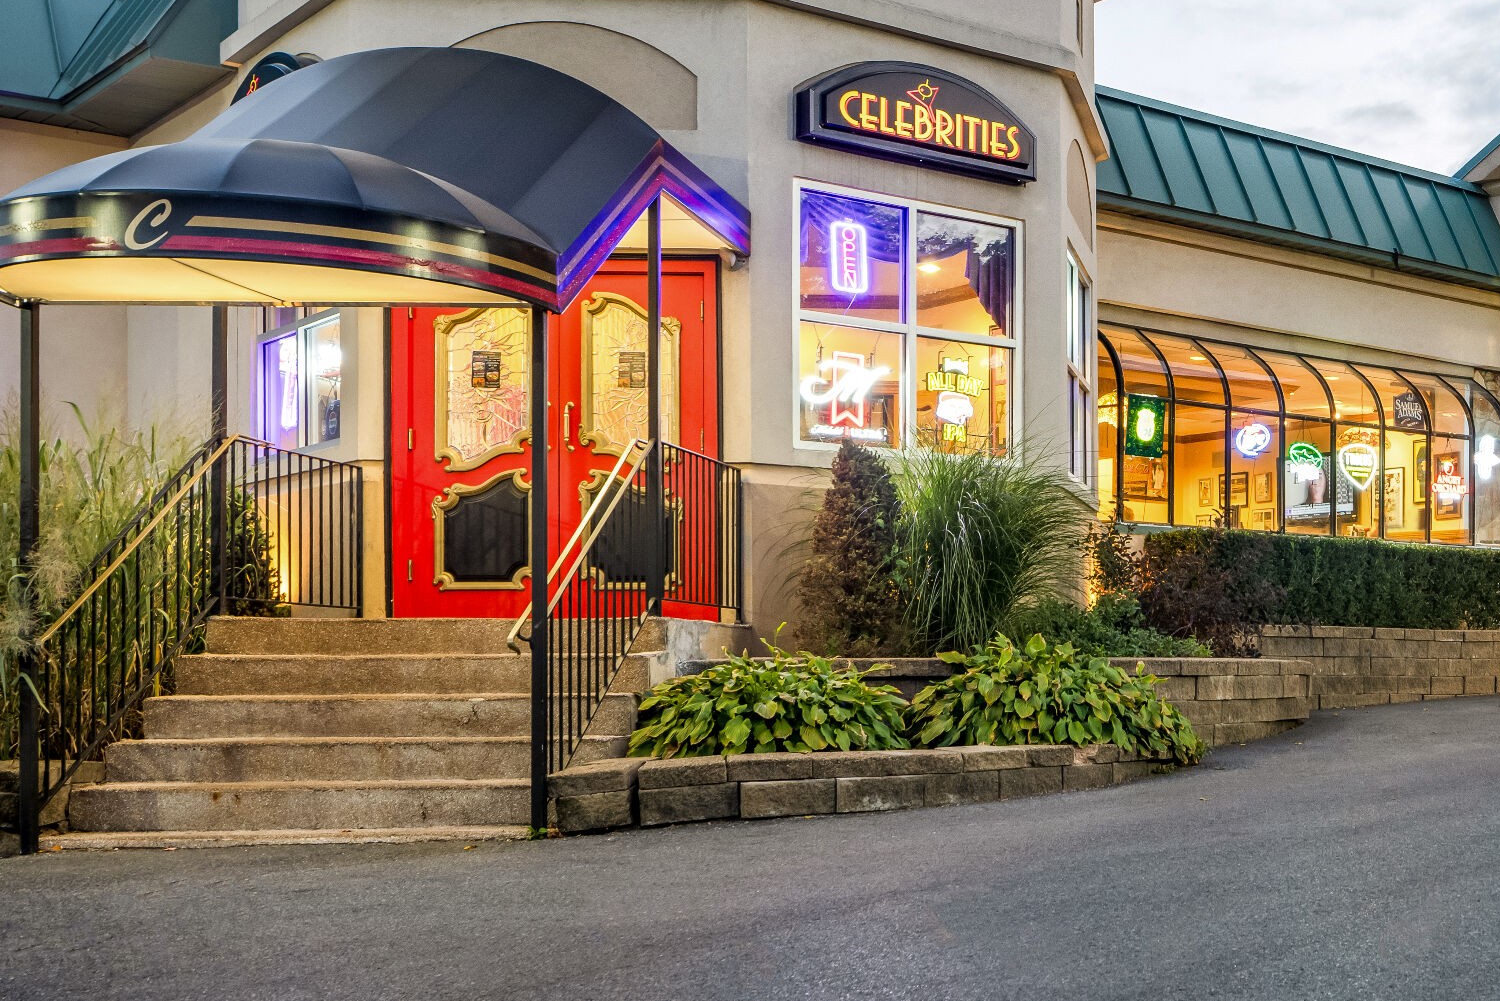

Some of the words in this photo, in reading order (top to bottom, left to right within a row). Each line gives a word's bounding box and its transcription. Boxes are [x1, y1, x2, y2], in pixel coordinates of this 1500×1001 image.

[839, 90, 1021, 161] CELEBRITIES
[125, 199, 172, 250] C
[842, 227, 857, 289] OPEN
[927, 372, 955, 391] ALL
[956, 374, 984, 397] DAY
[1397, 408, 1422, 420] ADAMS
[943, 424, 966, 442] IPA
[1432, 483, 1467, 494] ORCHARD
[1437, 475, 1461, 484] ANGRY
